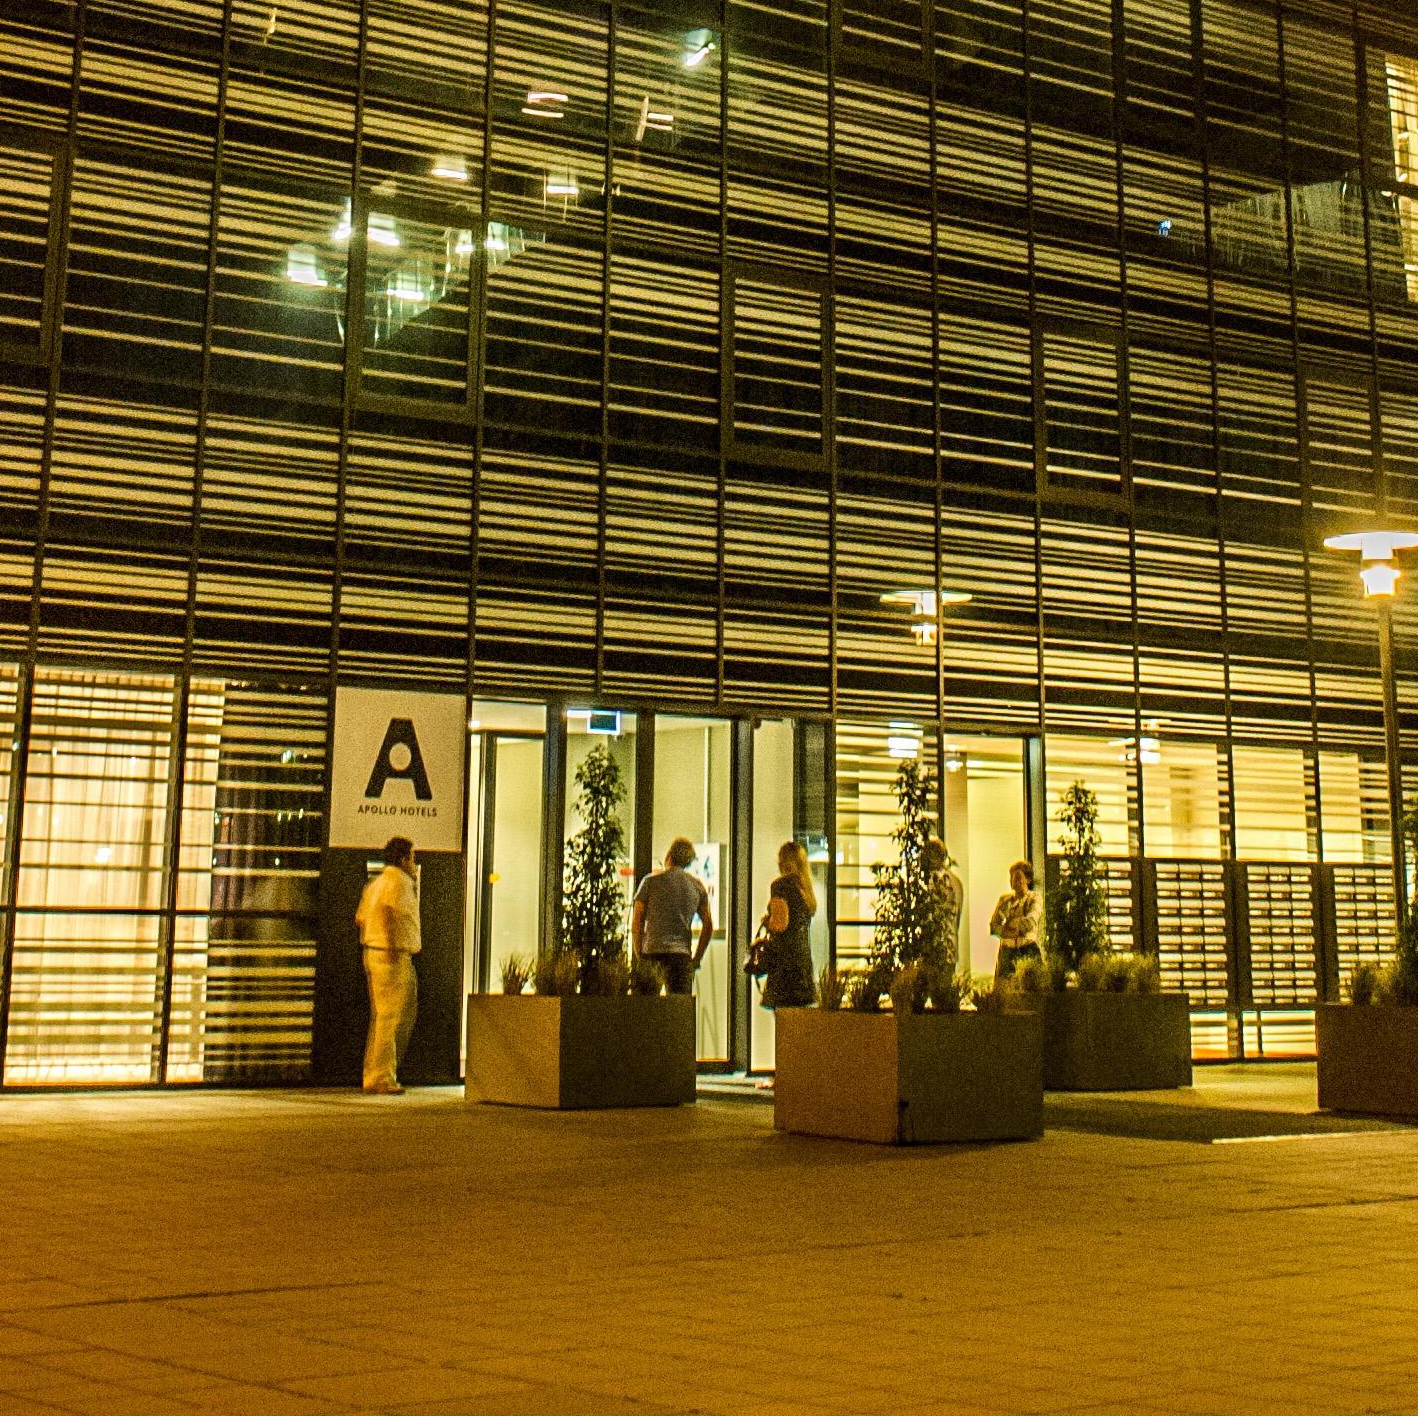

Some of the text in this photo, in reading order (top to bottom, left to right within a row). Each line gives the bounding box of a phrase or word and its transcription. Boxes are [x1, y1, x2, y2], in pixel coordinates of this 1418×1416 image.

[364, 717, 433, 801] A
[357, 804, 438, 818] APOLLO HOTELS
